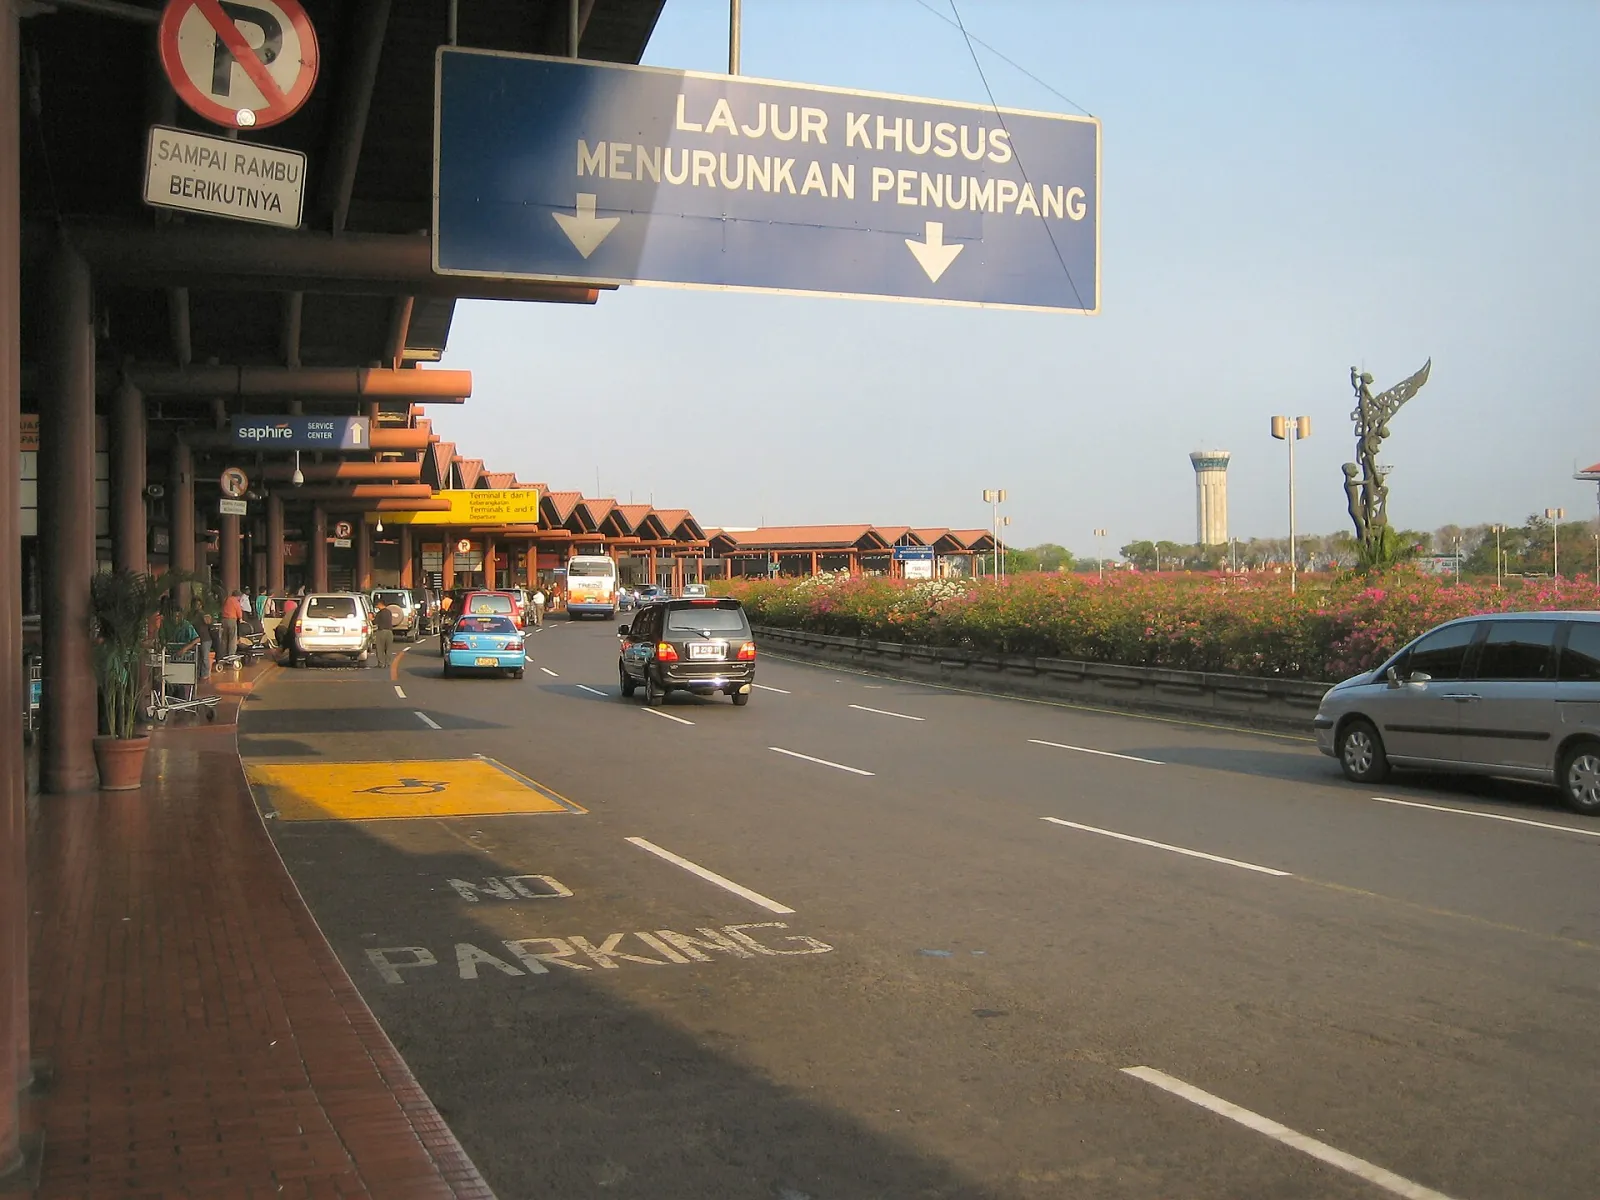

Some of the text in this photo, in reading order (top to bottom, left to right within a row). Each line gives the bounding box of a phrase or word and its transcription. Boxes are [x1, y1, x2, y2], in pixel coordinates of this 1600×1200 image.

[676, 93, 1012, 164] LAJUR KHUSUS
[158, 139, 298, 183] SAMPAI RAMBU
[169, 174, 282, 213] BERIKUTNYA
[576, 138, 1087, 221] MENURUNKAN PENUMPANG
[238, 424, 293, 441] saphire
[307, 422, 334, 430] SERVICE
[307, 431, 333, 439] CENTER
[469, 491, 500, 499] Terminal
[502, 491, 507, 499] E
[510, 491, 524, 499] dan
[446, 874, 576, 902] NO
[364, 921, 835, 984] PARKING
